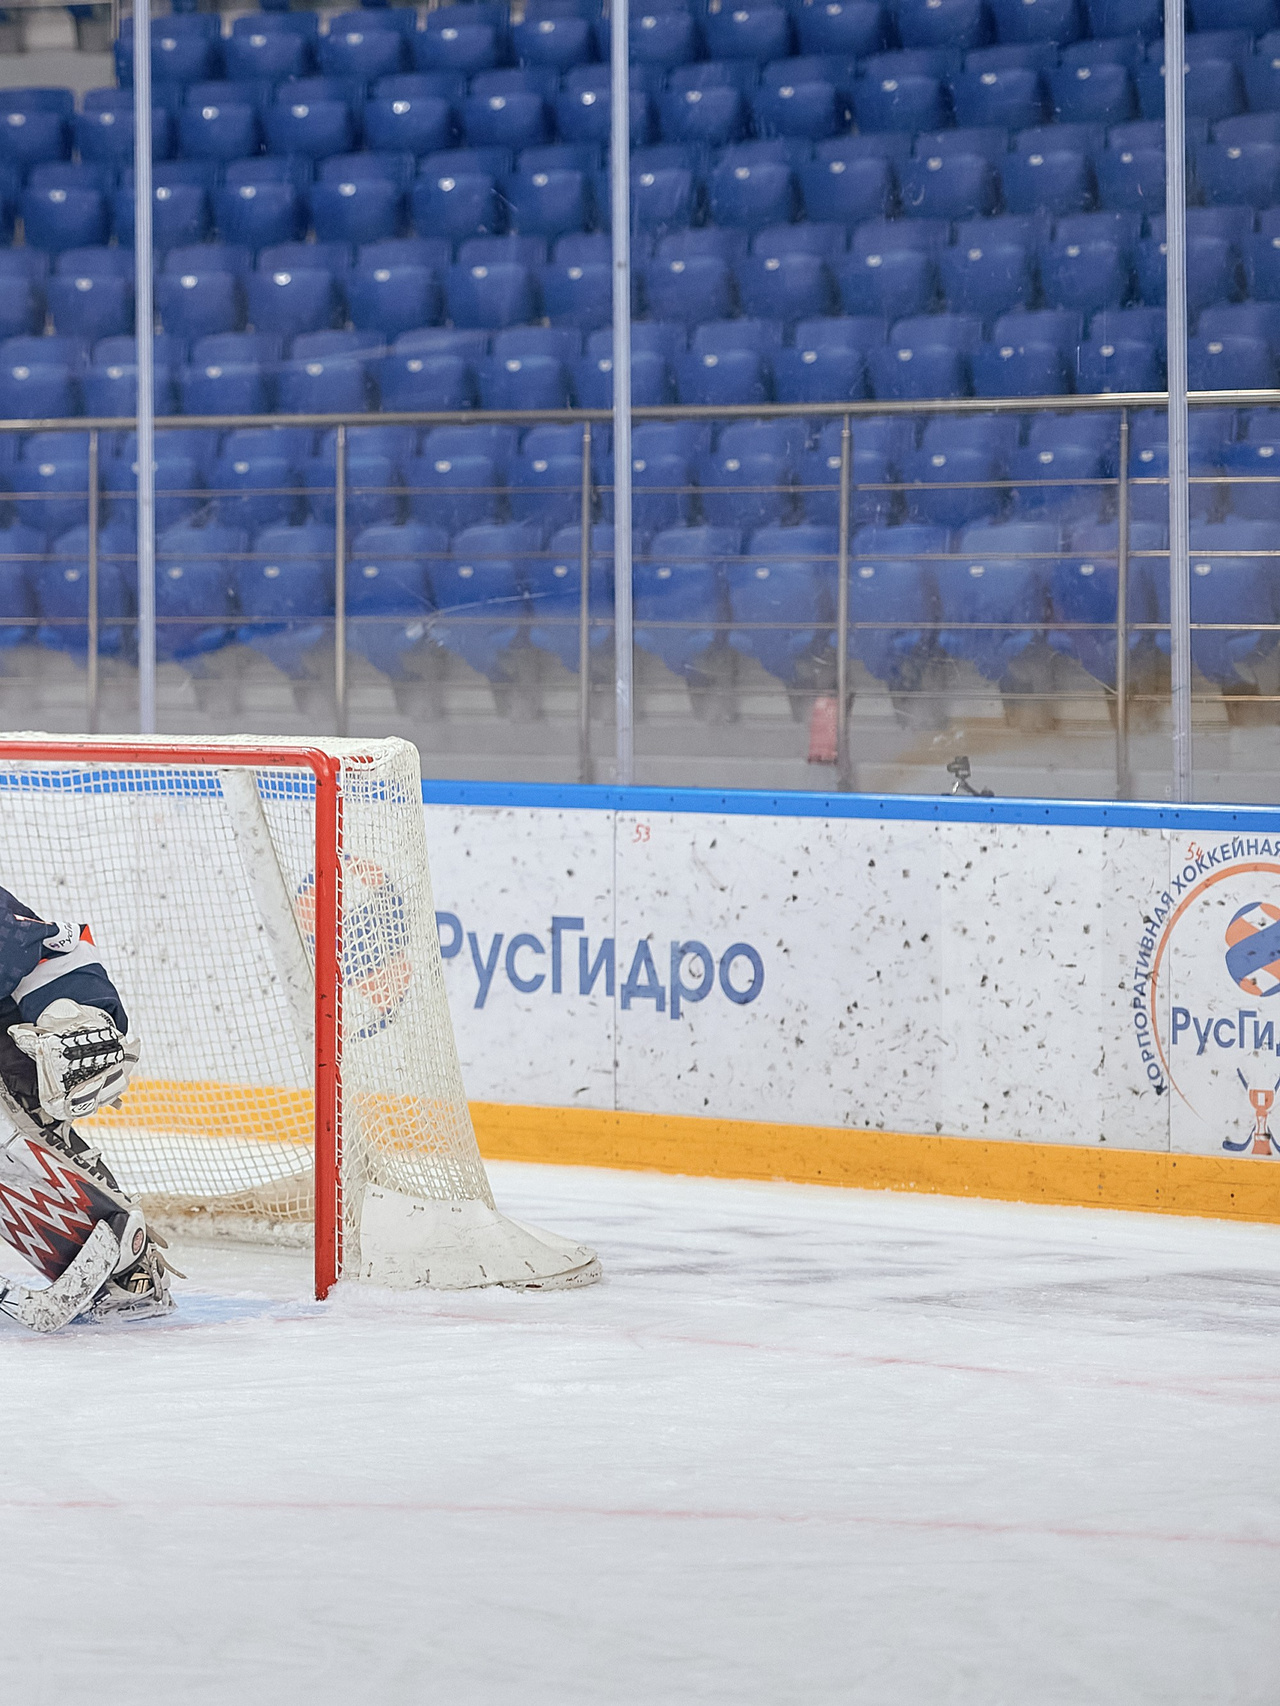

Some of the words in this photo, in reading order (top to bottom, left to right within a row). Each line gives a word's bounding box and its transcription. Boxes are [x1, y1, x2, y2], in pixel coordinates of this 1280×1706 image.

[632, 823, 651, 843] 53
[1184, 841, 1203, 861] 54
[434, 910, 765, 1020] РусГидро
[1133, 890, 1175, 1096] КОРПОРАТИВНАЯ
[1171, 1006, 1280, 1057] РусГи
